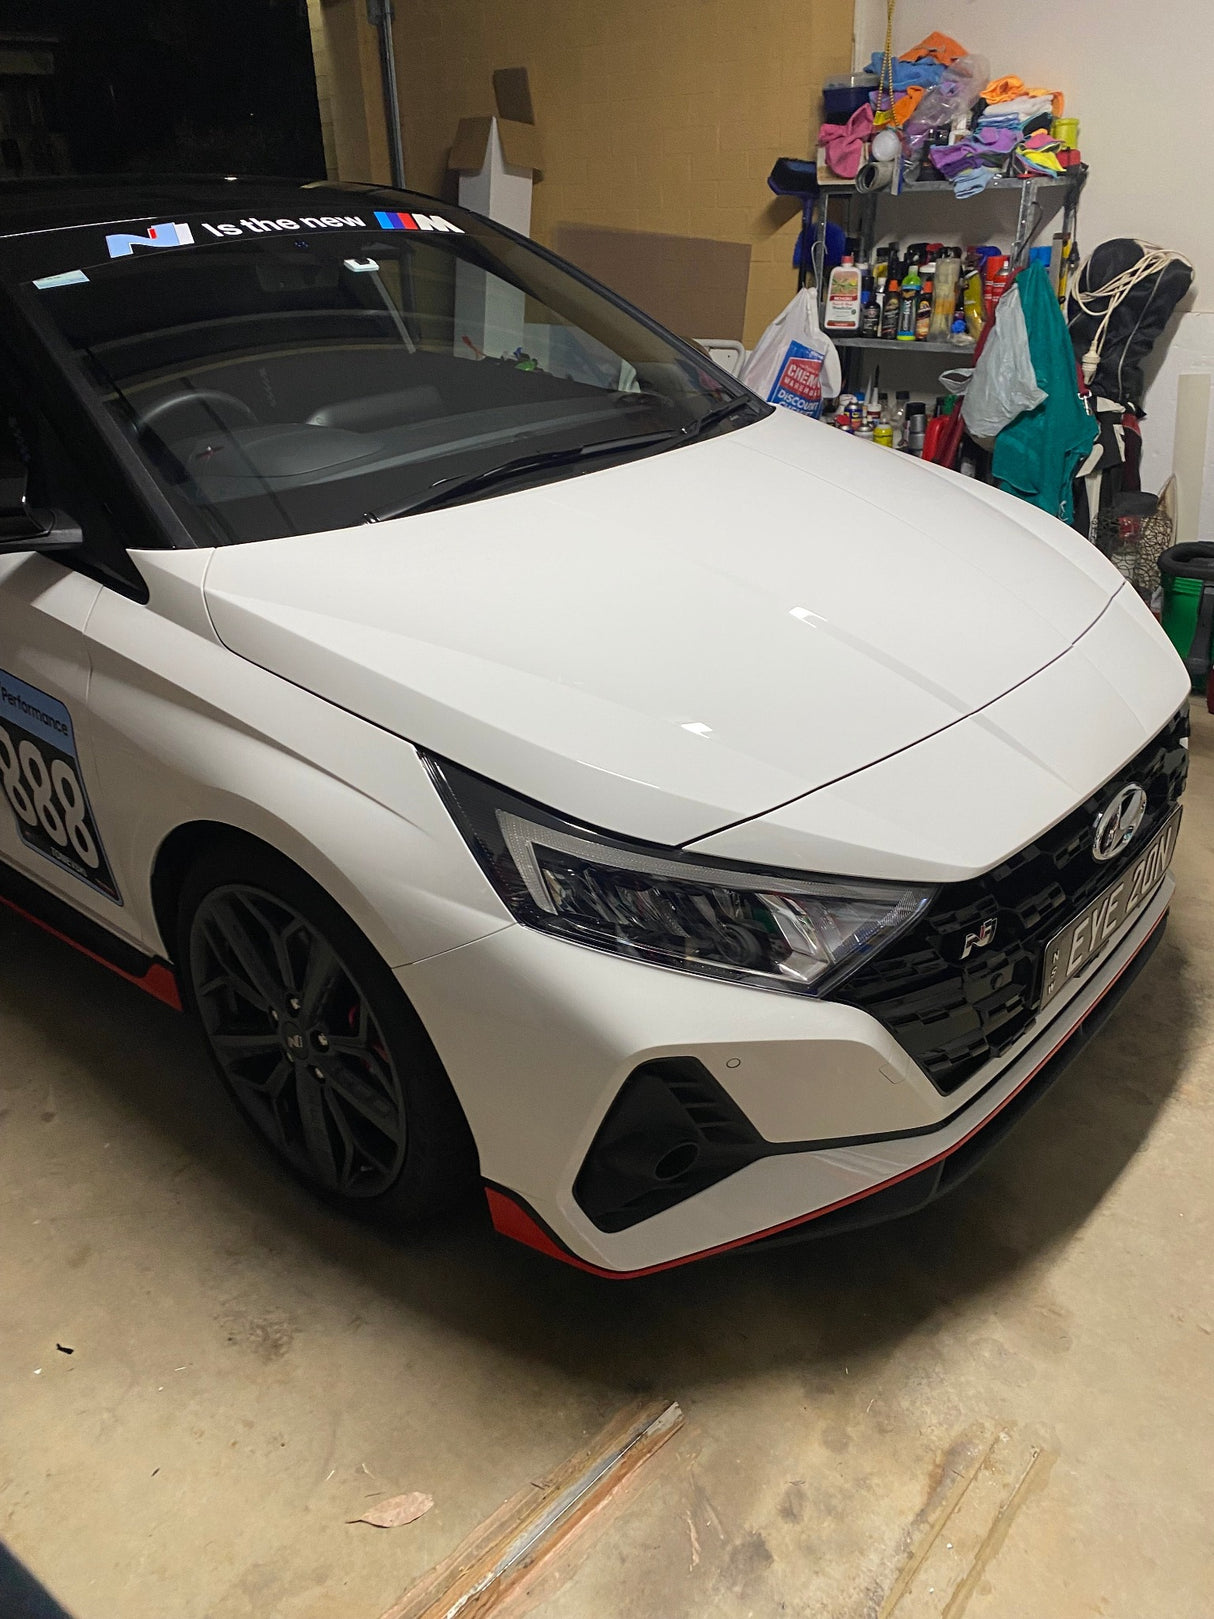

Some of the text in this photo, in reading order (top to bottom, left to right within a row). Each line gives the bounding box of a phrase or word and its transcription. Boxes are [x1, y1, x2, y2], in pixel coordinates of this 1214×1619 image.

[201, 223, 243, 237] Is
[239, 217, 301, 233] the
[299, 215, 367, 229] new
[411, 212, 466, 234] M
[1, 686, 69, 736] Performance
[0, 723, 100, 869] 888
[1066, 825, 1173, 977] EYE 20N
